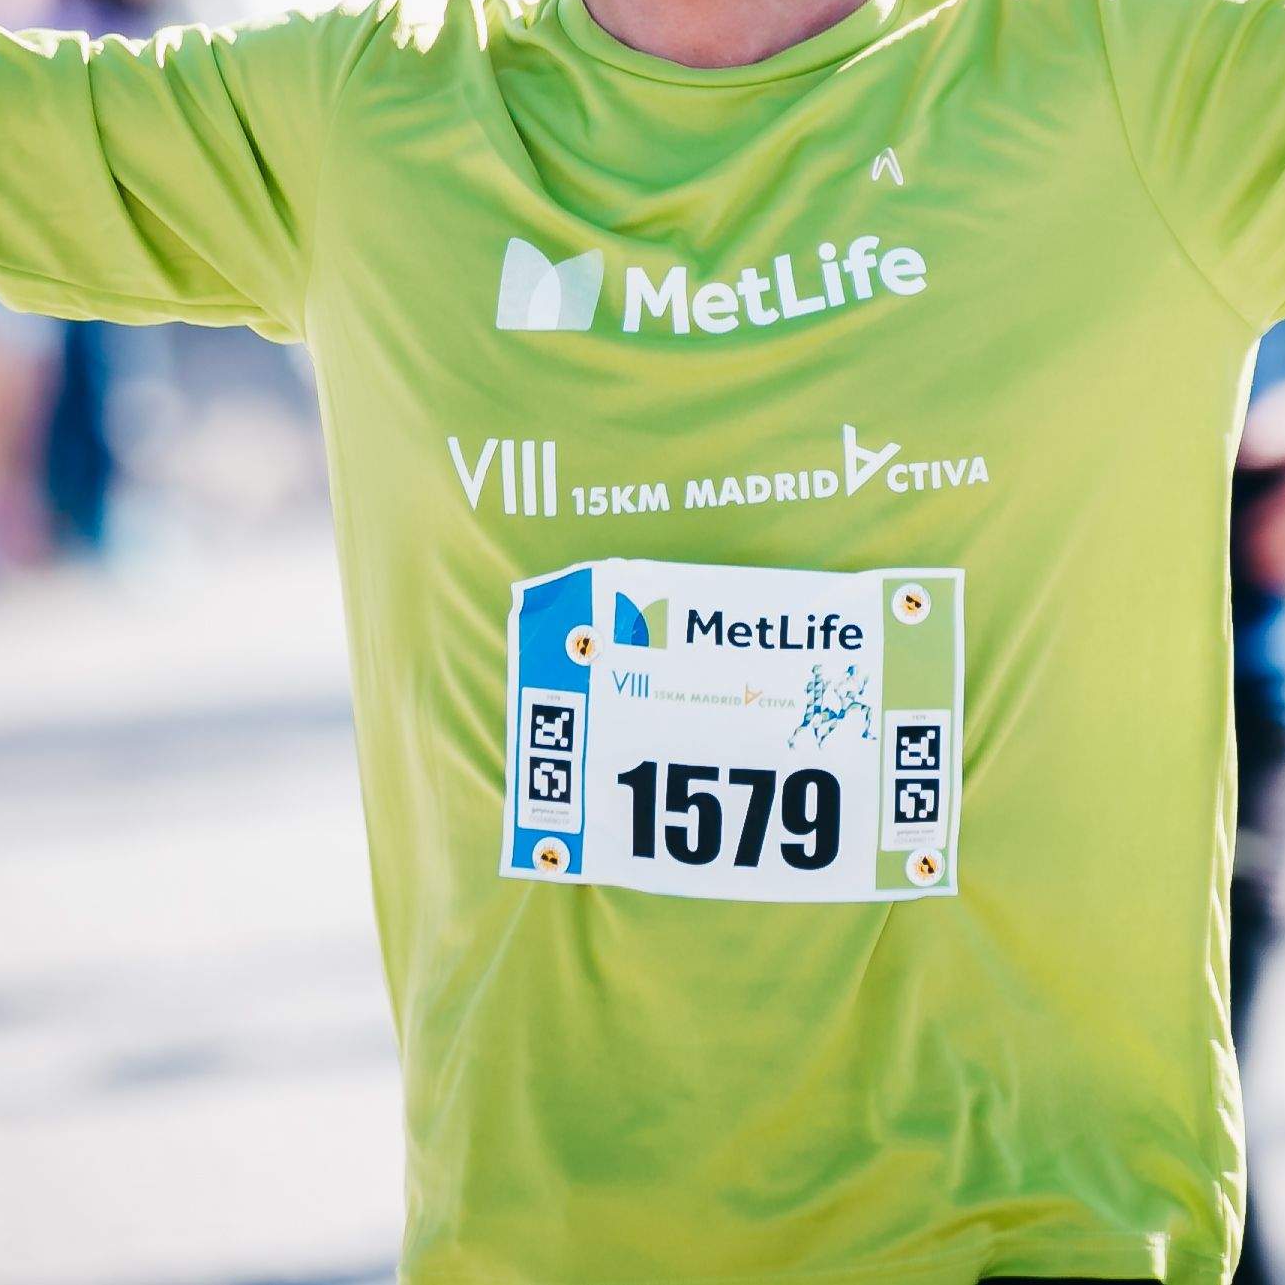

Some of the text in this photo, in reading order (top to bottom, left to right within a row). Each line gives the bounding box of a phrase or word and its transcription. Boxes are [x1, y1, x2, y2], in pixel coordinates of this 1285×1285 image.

[622, 235, 928, 335] MetLife
[447, 435, 557, 517] VIII
[571, 482, 671, 516] 15KM
[686, 609, 863, 650] MetLife
[611, 670, 649, 699] VIII
[653, 690, 686, 702] 15KM
[617, 760, 841, 871] 1579
